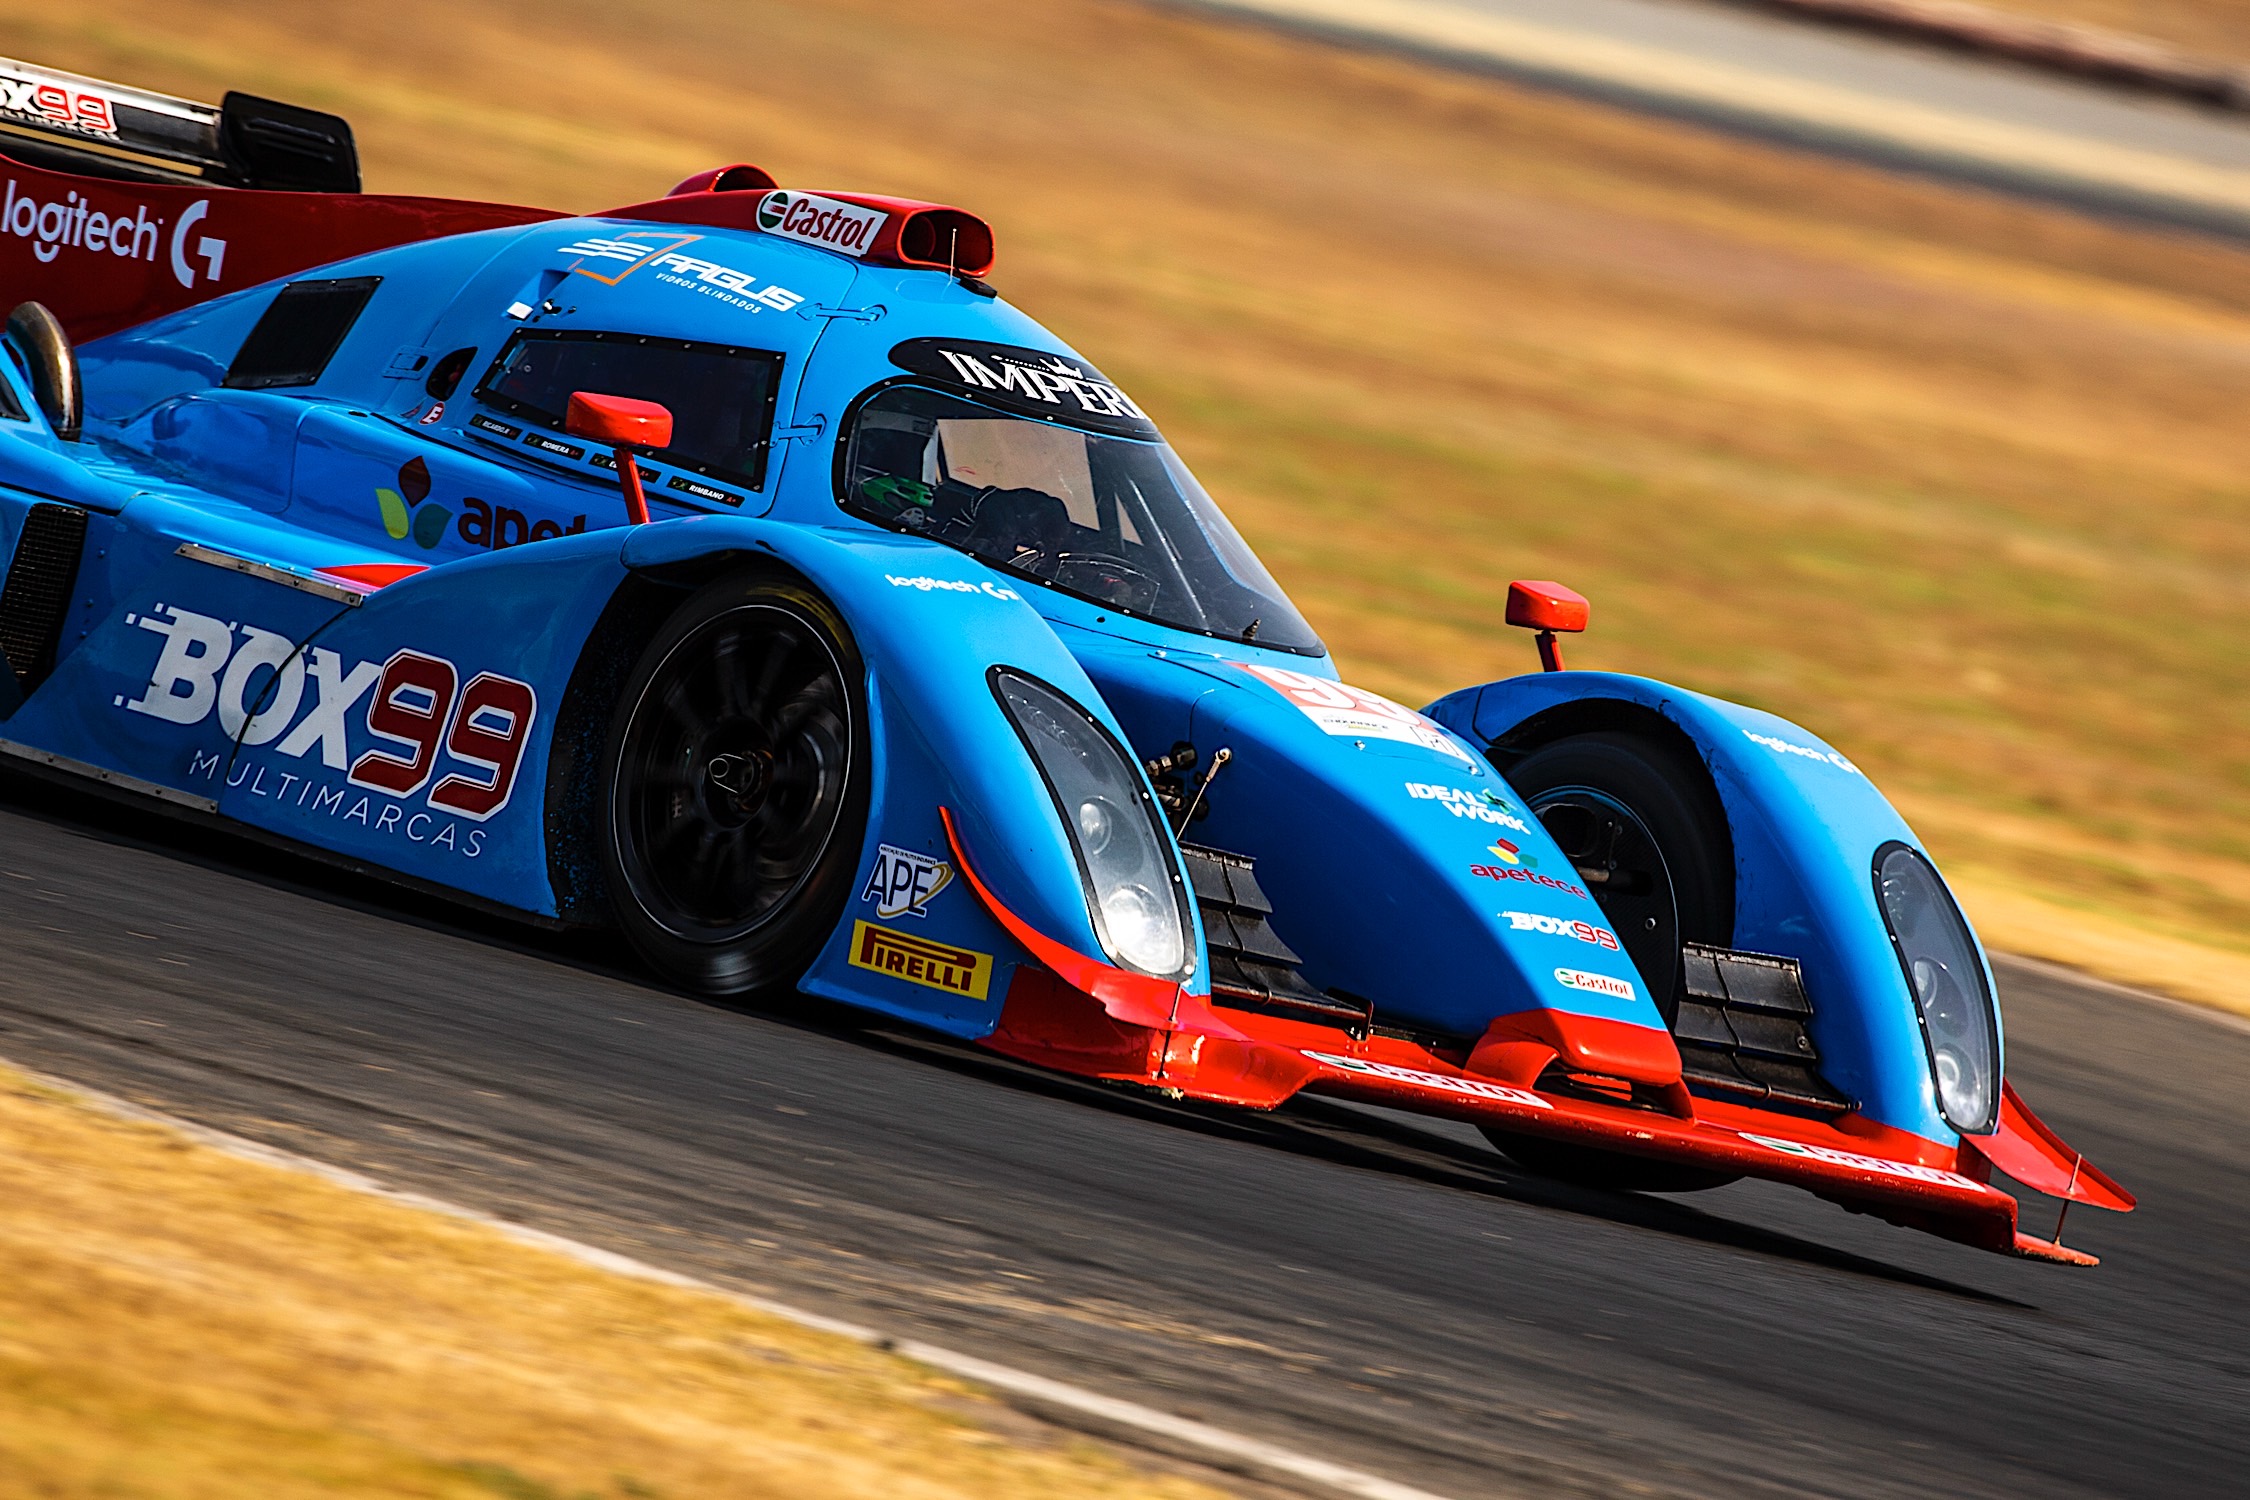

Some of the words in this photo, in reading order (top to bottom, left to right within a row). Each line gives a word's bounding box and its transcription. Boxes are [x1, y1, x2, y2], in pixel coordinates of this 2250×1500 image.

[0, 80, 117, 133] X99
[1, 179, 158, 263] logitech
[170, 200, 227, 289] G
[781, 198, 877, 251] Castrol
[650, 253, 805, 312] ARGUS
[655, 272, 698, 289] VIDROS
[697, 285, 763, 314] BLINDADOS
[421, 405, 444, 423] E
[541, 440, 570, 454] ROMERA
[688, 484, 725, 501] RIMBANO
[113, 602, 537, 822] BOX99
[188, 749, 487, 858] MULTIMARCAS
[1404, 782, 1488, 809] IDEAL
[1441, 800, 1532, 836] WORK
[863, 853, 933, 916] APE
[1469, 864, 1589, 900] apetece
[1497, 911, 1620, 951] BOX99
[859, 925, 977, 992] PIRELLI
[1575, 973, 1630, 997] Castrol
